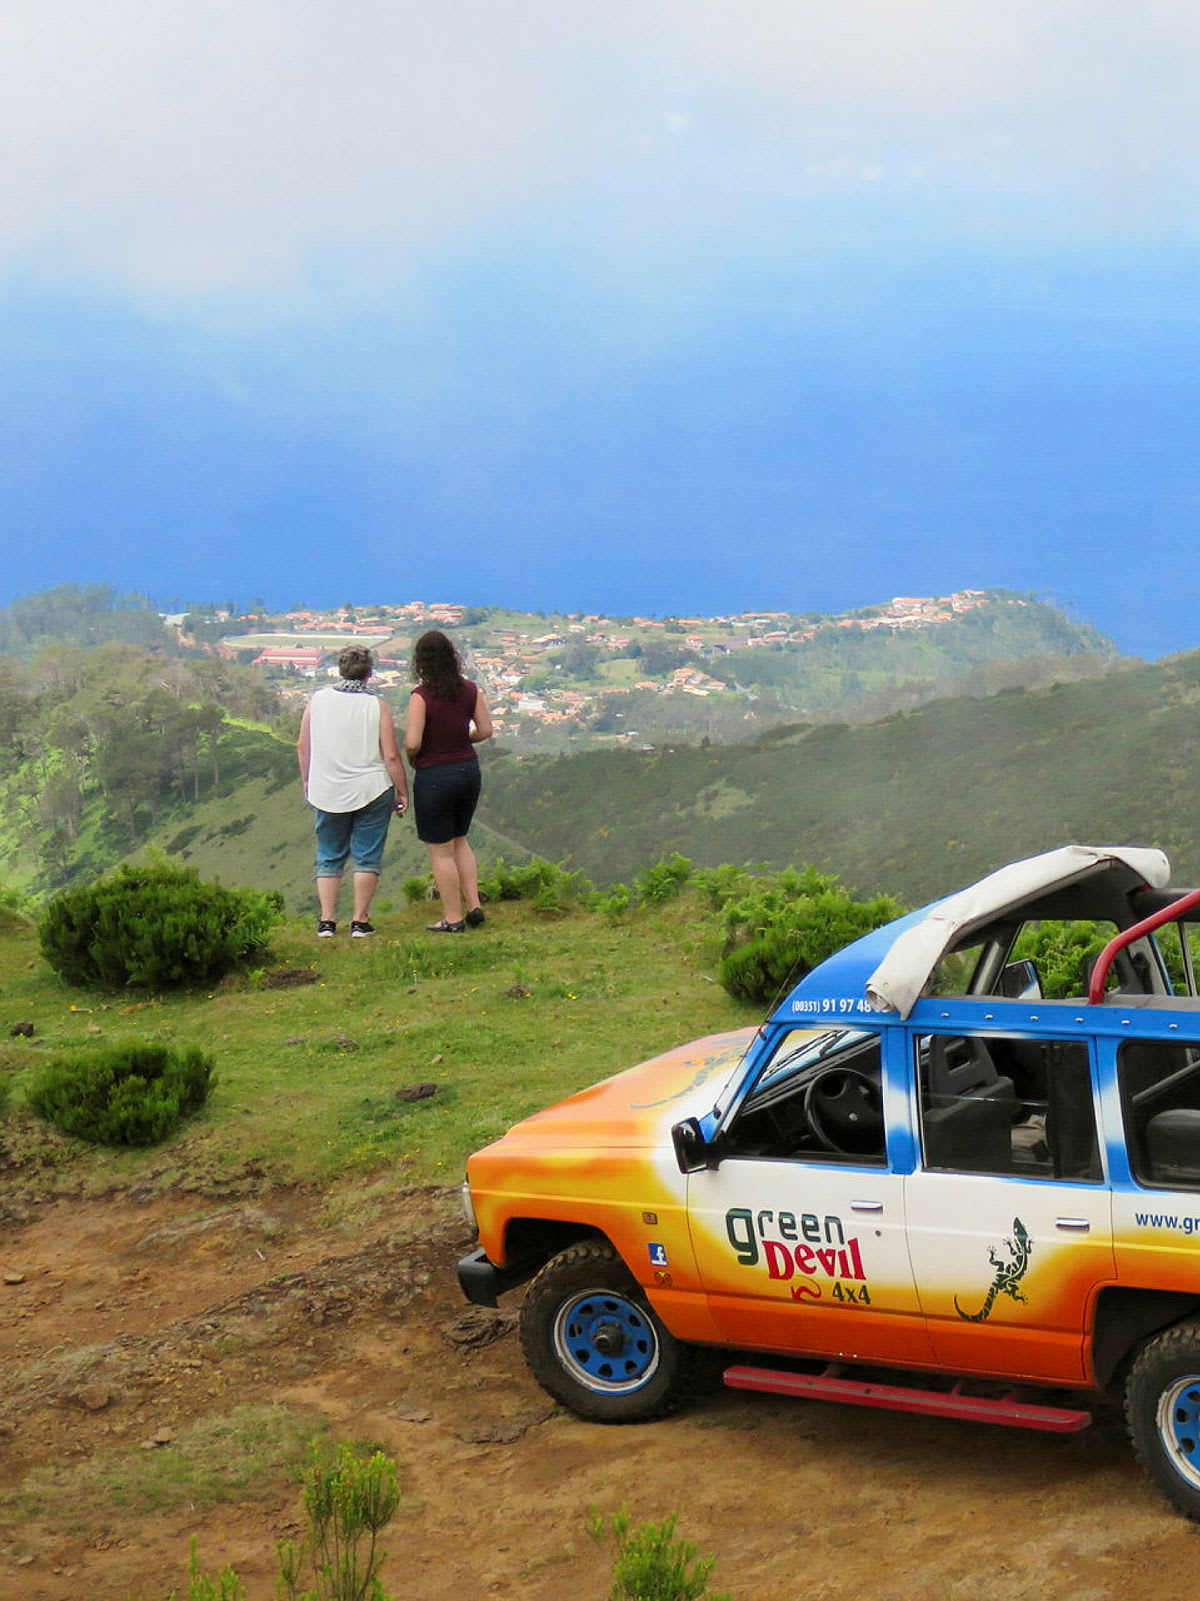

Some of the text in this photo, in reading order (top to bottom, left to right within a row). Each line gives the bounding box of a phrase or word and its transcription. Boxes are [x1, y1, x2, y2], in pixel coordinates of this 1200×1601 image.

[822, 998, 836, 1012] 91
[839, 998, 855, 1012] 97
[725, 1207, 845, 1266] green
[761, 1237, 867, 1280] Devil
[832, 1281, 871, 1304] 4x4
